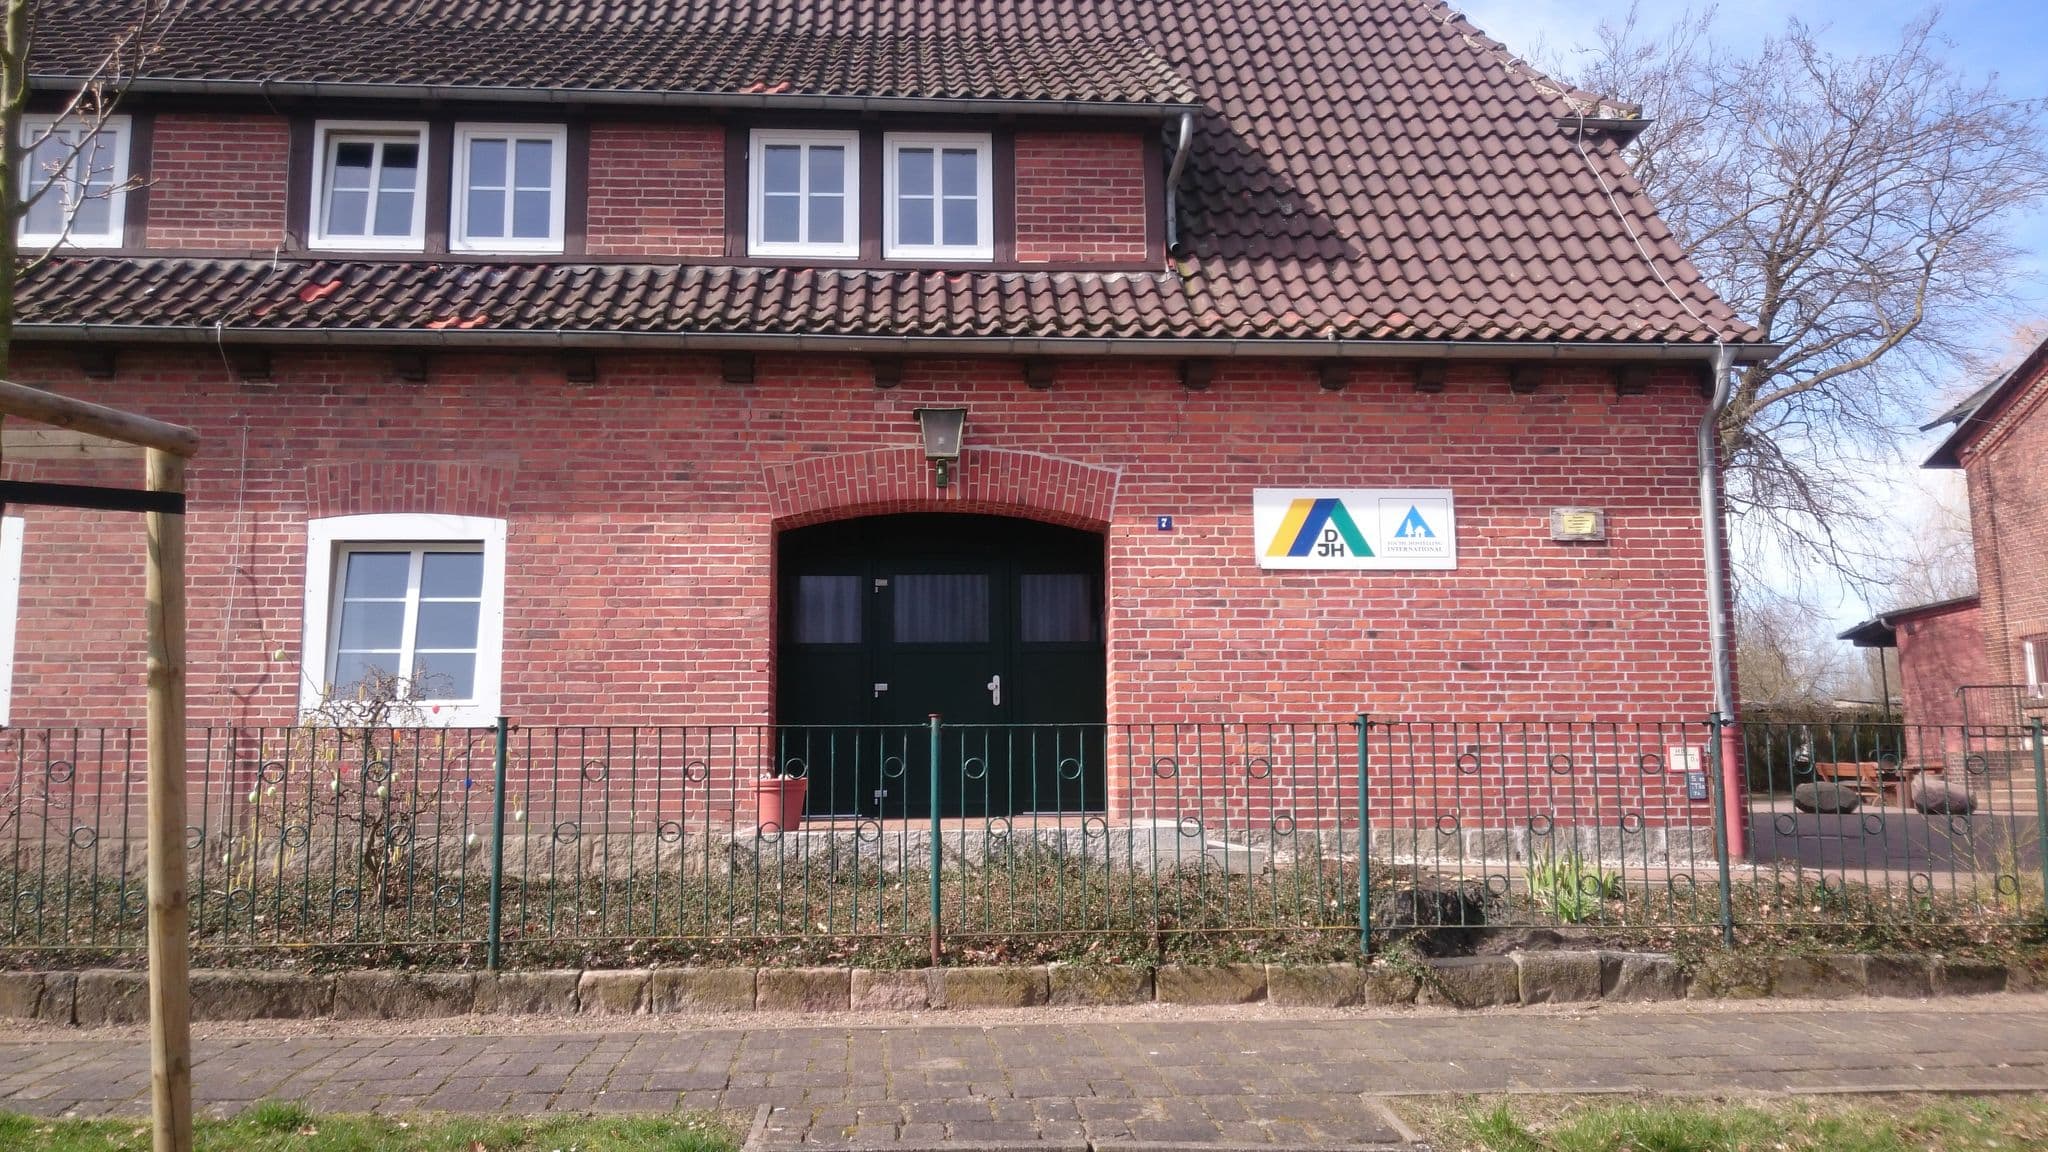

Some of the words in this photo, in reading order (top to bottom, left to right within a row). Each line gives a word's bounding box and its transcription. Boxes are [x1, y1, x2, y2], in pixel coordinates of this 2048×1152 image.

[1160, 517, 1168, 528] 7
[1324, 529, 1339, 543] D
[1317, 543, 1345, 558] JH
